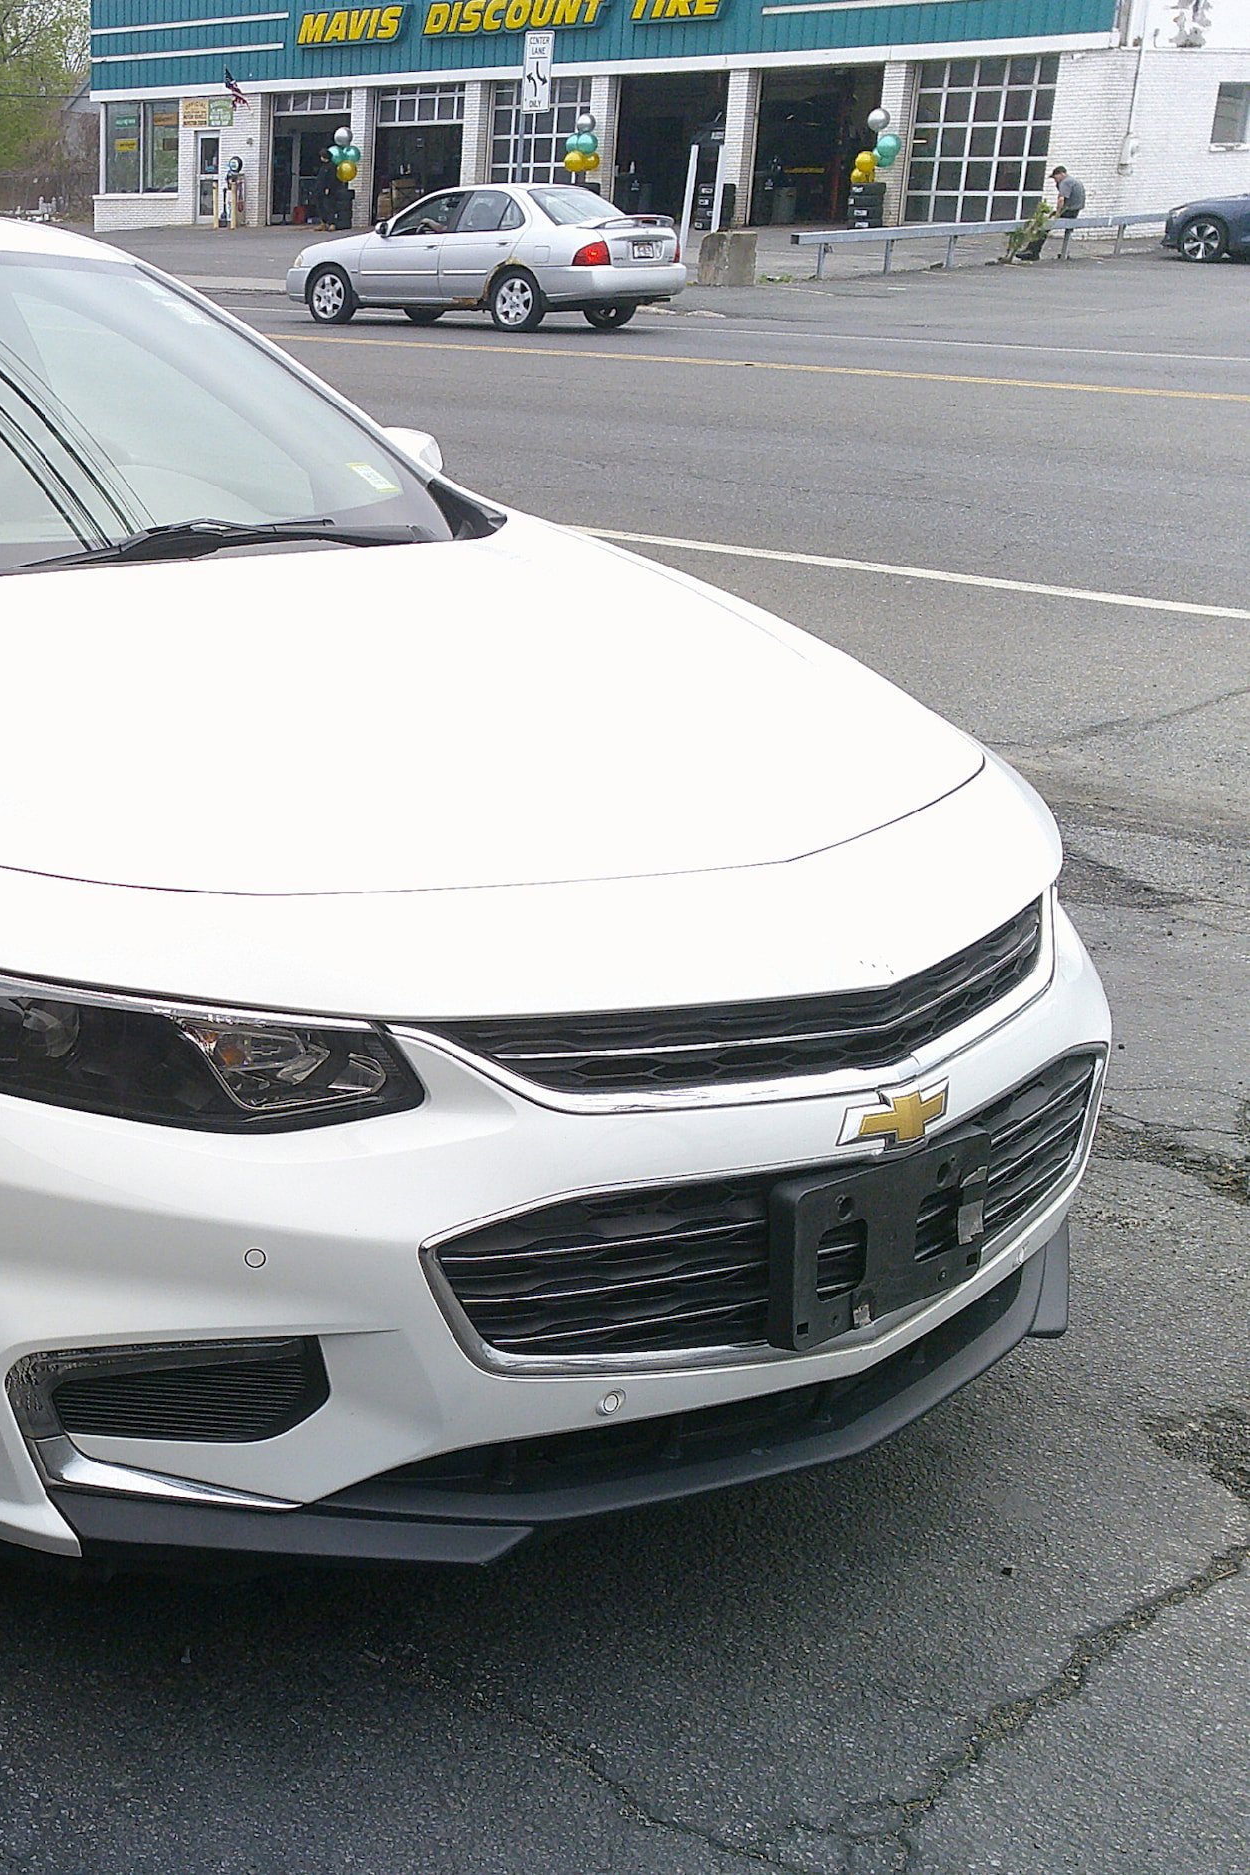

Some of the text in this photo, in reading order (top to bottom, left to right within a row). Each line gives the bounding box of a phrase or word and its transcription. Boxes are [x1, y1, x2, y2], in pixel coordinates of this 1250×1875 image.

[297, 6, 404, 44] MAVIS
[422, 0, 602, 35] DISCOUNT
[530, 36, 550, 45] CENTER
[531, 46, 546, 55] LANE
[529, 100, 541, 108] ONLY
